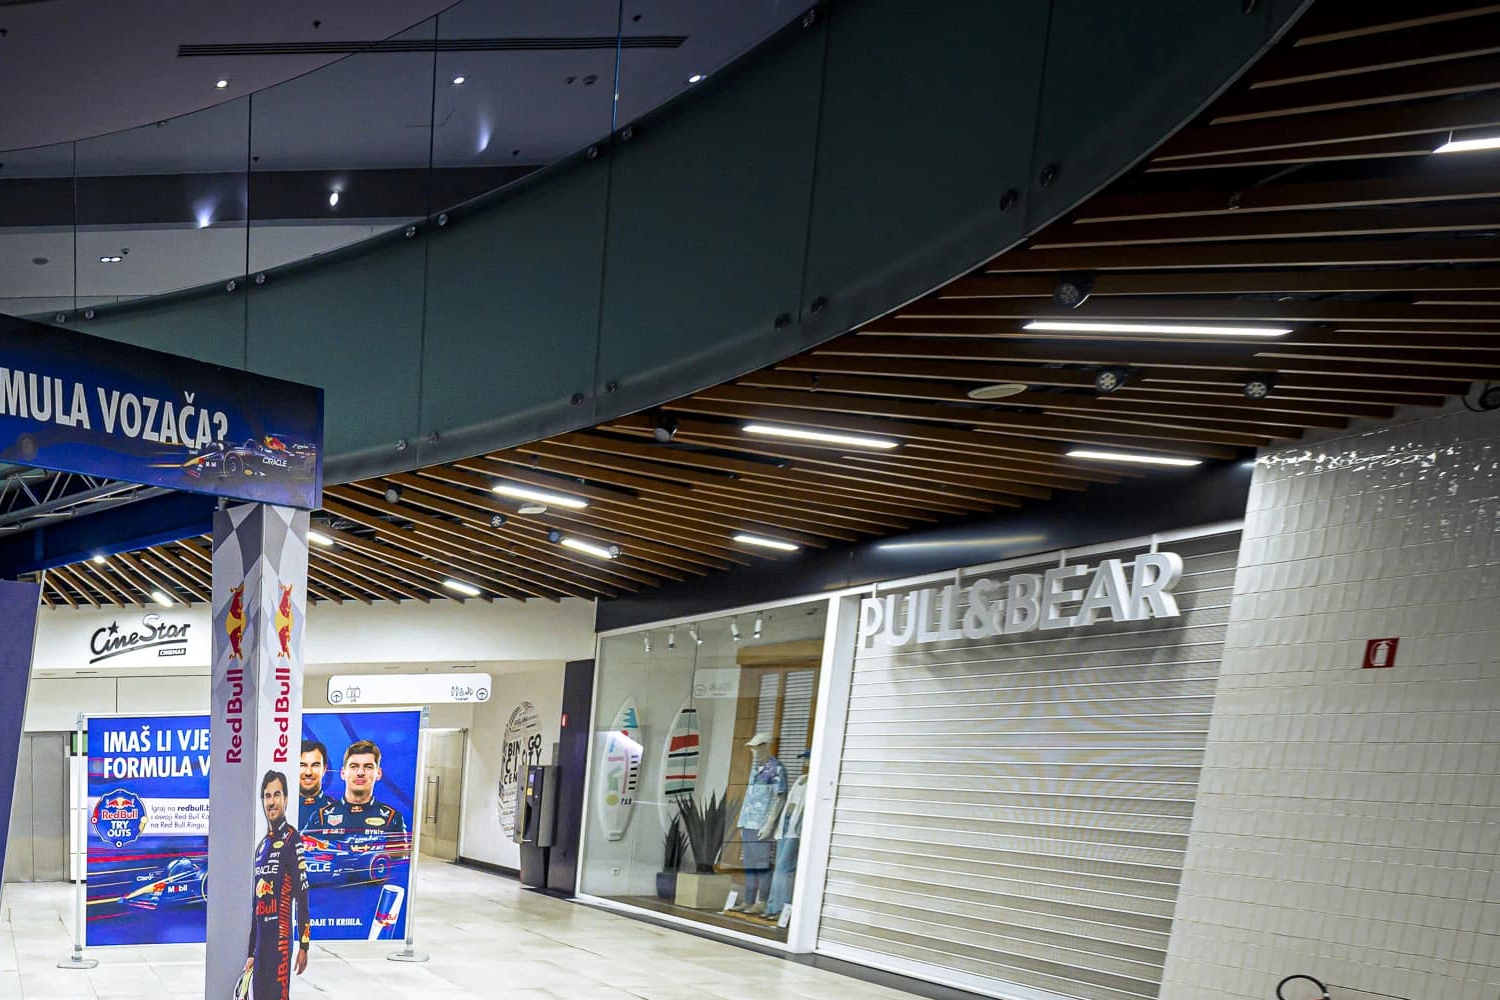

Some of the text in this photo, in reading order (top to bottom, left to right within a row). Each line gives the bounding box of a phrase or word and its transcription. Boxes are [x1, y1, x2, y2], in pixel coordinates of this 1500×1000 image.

[97, 391, 228, 450] VOZAČA?
[857, 551, 1185, 651] PULL&BEAR
[226, 668, 244, 764] Red Bull
[273, 667, 291, 763] Red Bull
[103, 725, 210, 753] IMAŠ LI VJE
[103, 755, 210, 779] FORMULA V
[102, 809, 139, 819] Red Bull
[110, 820, 129, 829] TRY
[107, 828, 132, 838] OUTS
[167, 884, 188, 893] Mobil
